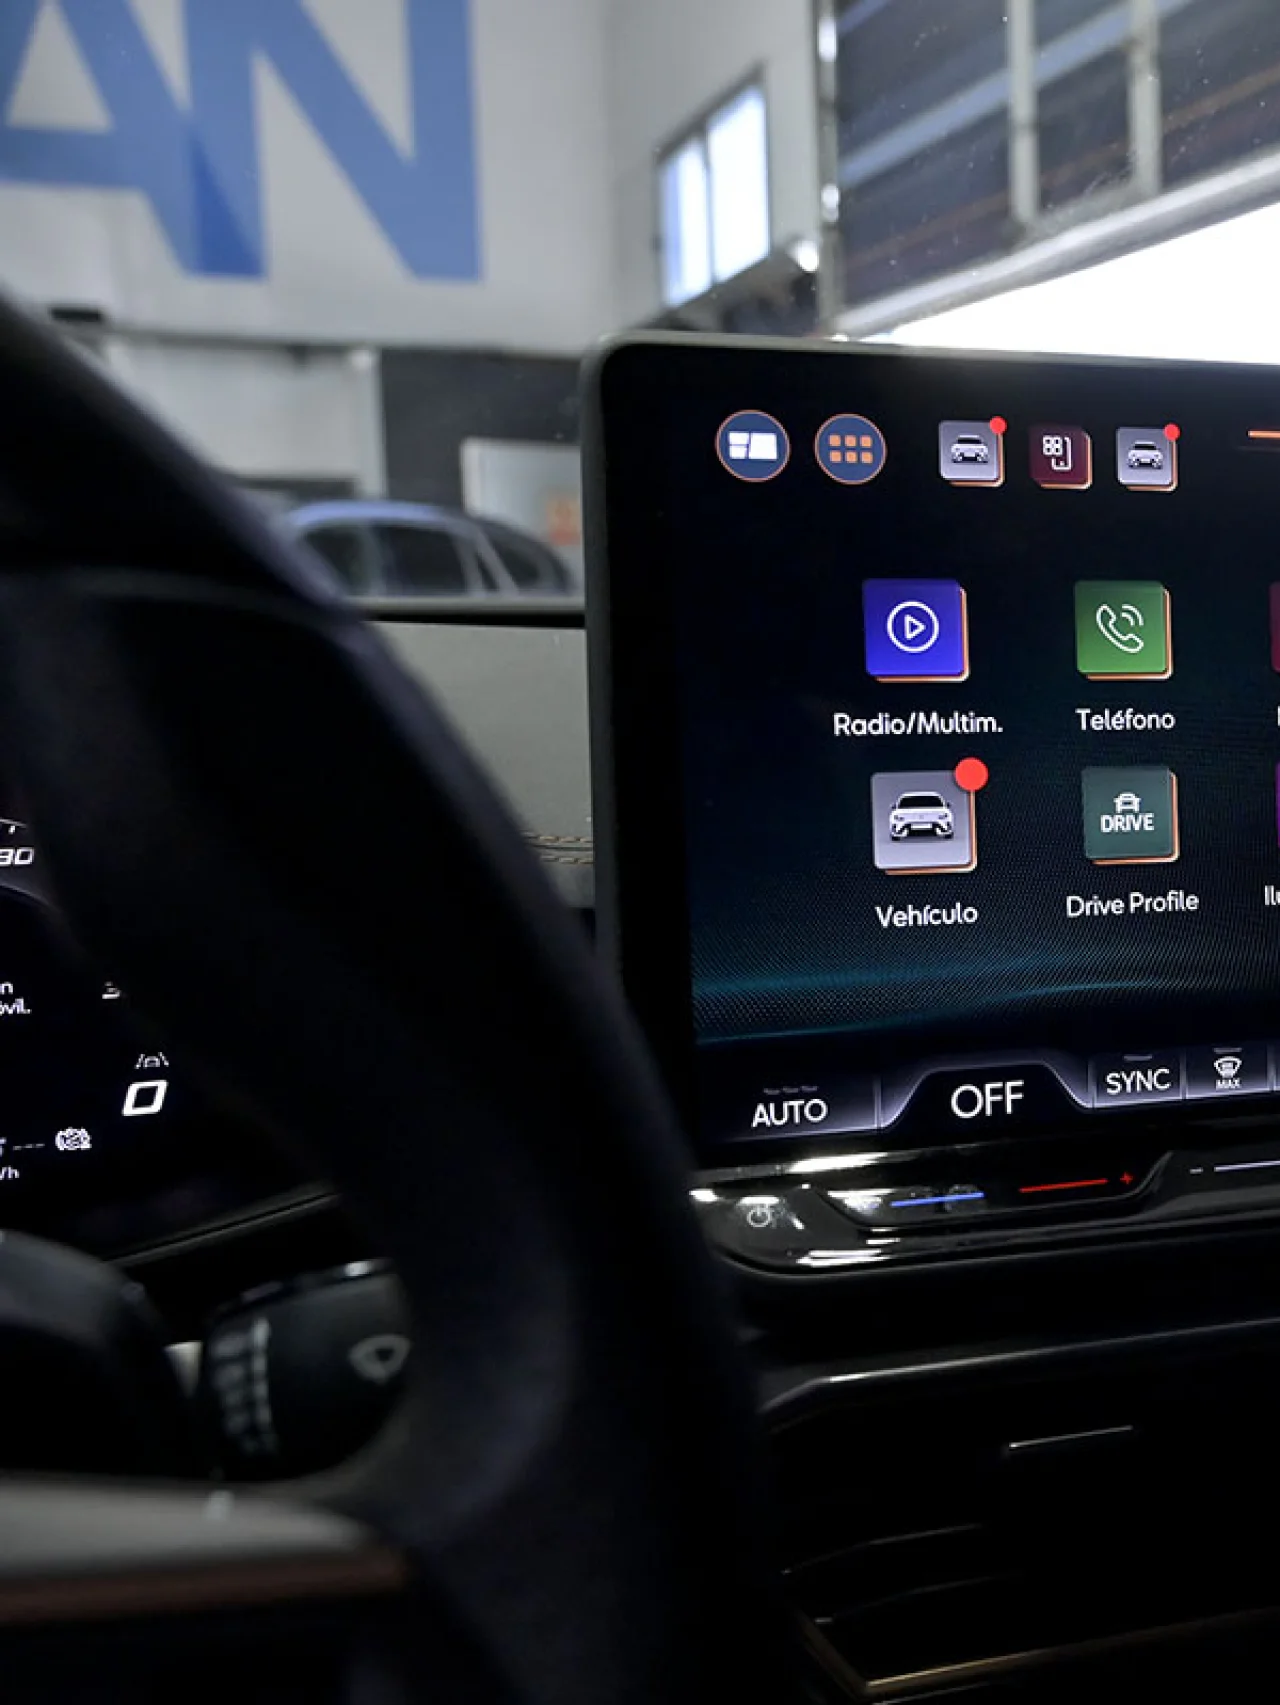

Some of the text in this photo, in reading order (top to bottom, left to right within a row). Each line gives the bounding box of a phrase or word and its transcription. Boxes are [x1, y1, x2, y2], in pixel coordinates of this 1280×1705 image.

[833, 710, 1004, 737] Radio/Multim.
[1075, 706, 1176, 731] Teléfono
[1100, 814, 1155, 833] DRIVE
[874, 901, 979, 928] Vehículo
[1066, 889, 1200, 919] Drive Profile
[1105, 1067, 1171, 1094] SYNC
[950, 1079, 1025, 1119] OFF
[752, 1098, 828, 1128] AUTO
